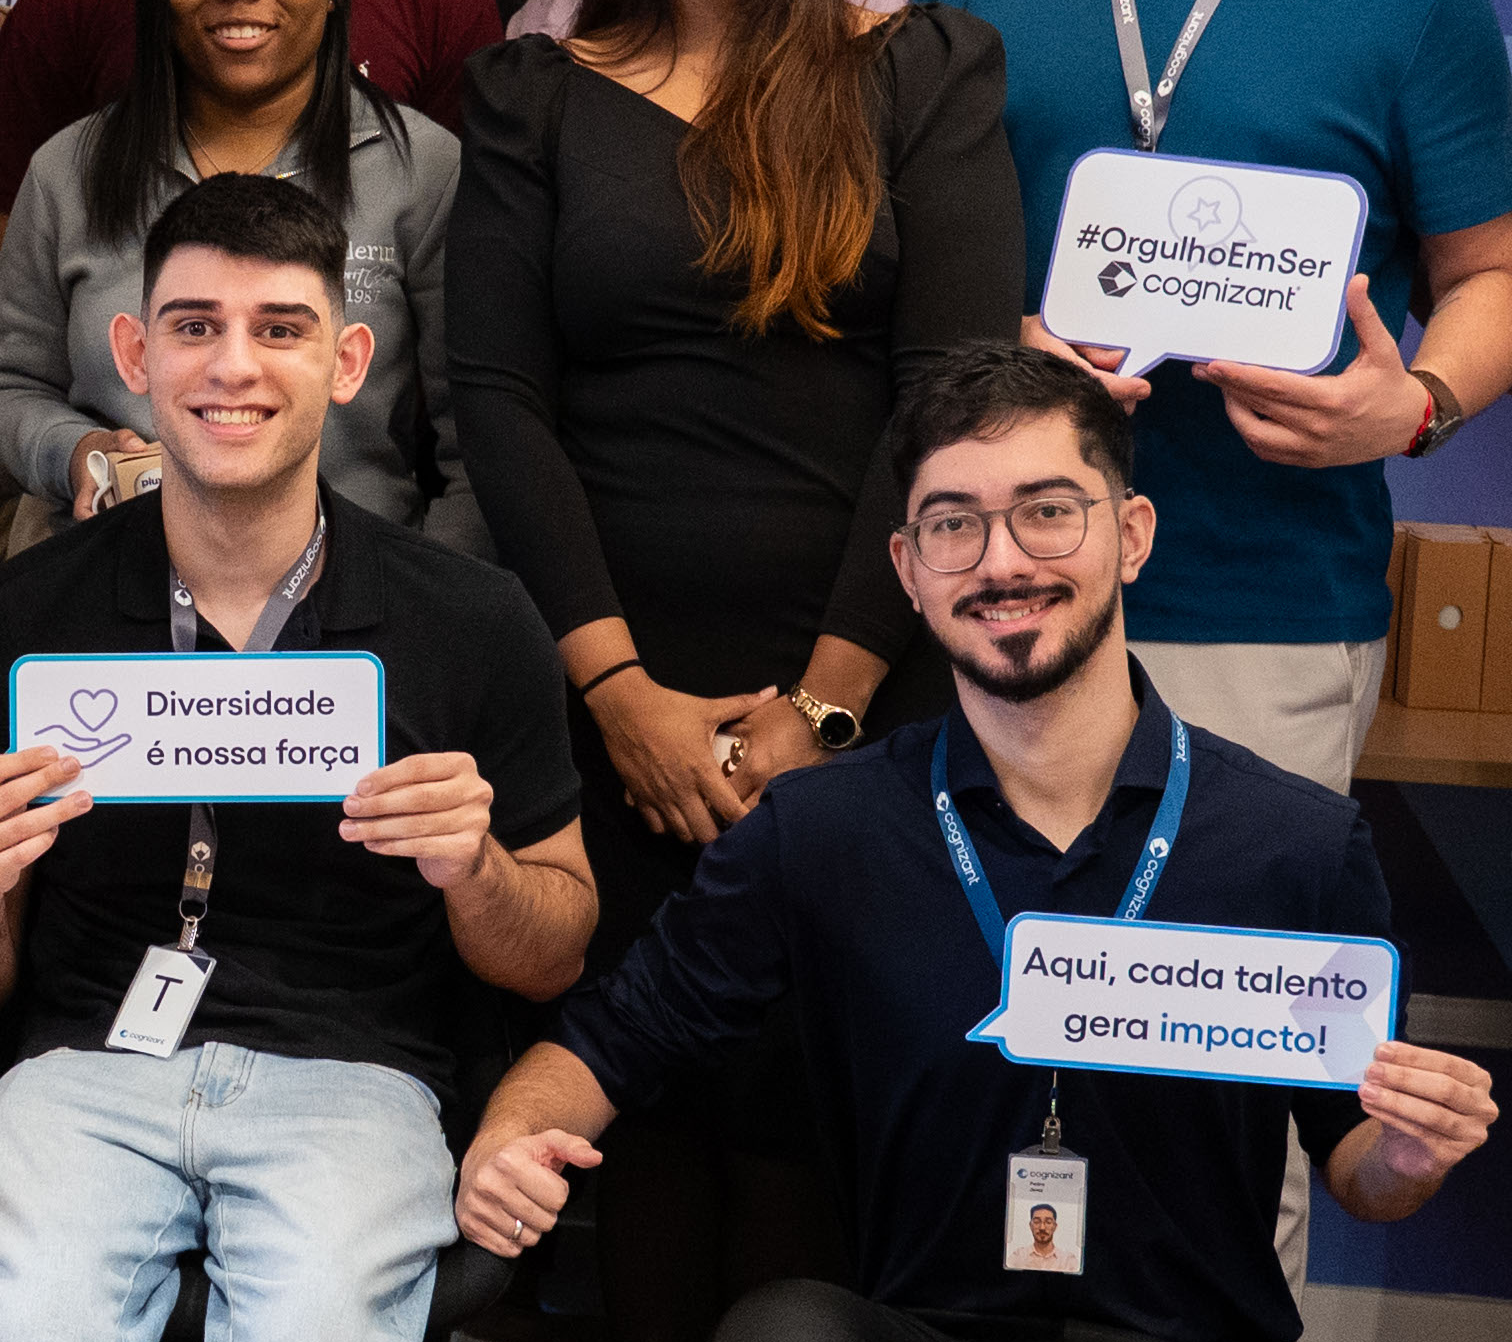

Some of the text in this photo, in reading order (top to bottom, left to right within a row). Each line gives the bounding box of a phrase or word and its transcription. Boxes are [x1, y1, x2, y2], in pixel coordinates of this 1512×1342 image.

[1167, 10, 1205, 78] cognizant
[1076, 224, 1332, 279] #OrgulhoEmSer
[1142, 274, 1296, 311] cognizant
[282, 533, 324, 600] cognizant
[147, 689, 335, 717] Diversidade
[147, 738, 359, 772] é nossa força
[943, 810, 981, 887] cognizant
[1126, 859, 1159, 921] cogniza
[154, 974, 184, 1013] T
[1022, 946, 1368, 1001] Aqui, cada talento
[128, 1030, 166, 1046] cognizant
[1064, 1012, 1327, 1055] gera impacto!
[1029, 1170, 1074, 1180] cognizant
